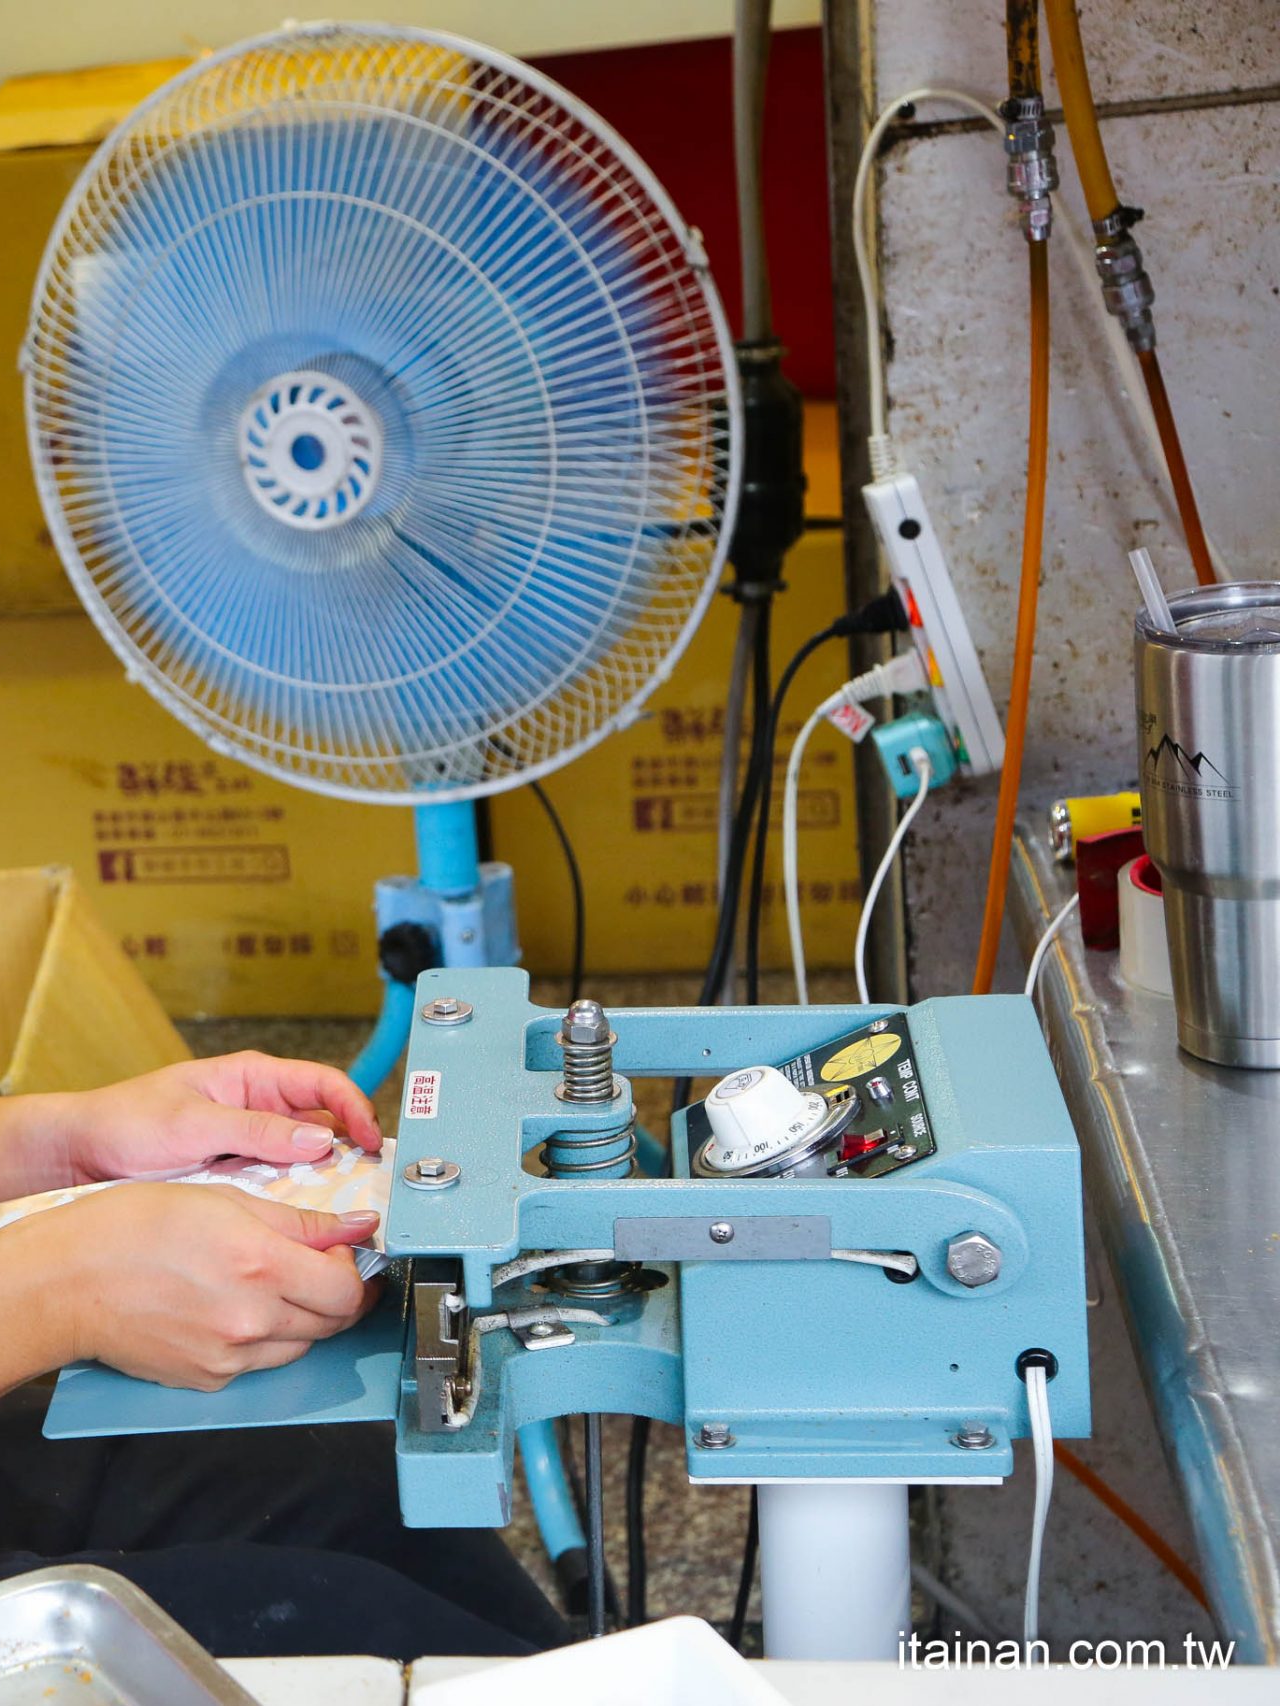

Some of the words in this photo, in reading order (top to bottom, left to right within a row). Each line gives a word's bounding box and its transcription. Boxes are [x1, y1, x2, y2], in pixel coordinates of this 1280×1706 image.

[1206, 789, 1234, 799] STEEL
[896, 1058, 914, 1079] TEMP
[902, 1080, 920, 1103] CONT
[788, 1121, 805, 1134] 150
[910, 1112, 927, 1138] SOURCE
[753, 1141, 770, 1153] 100
